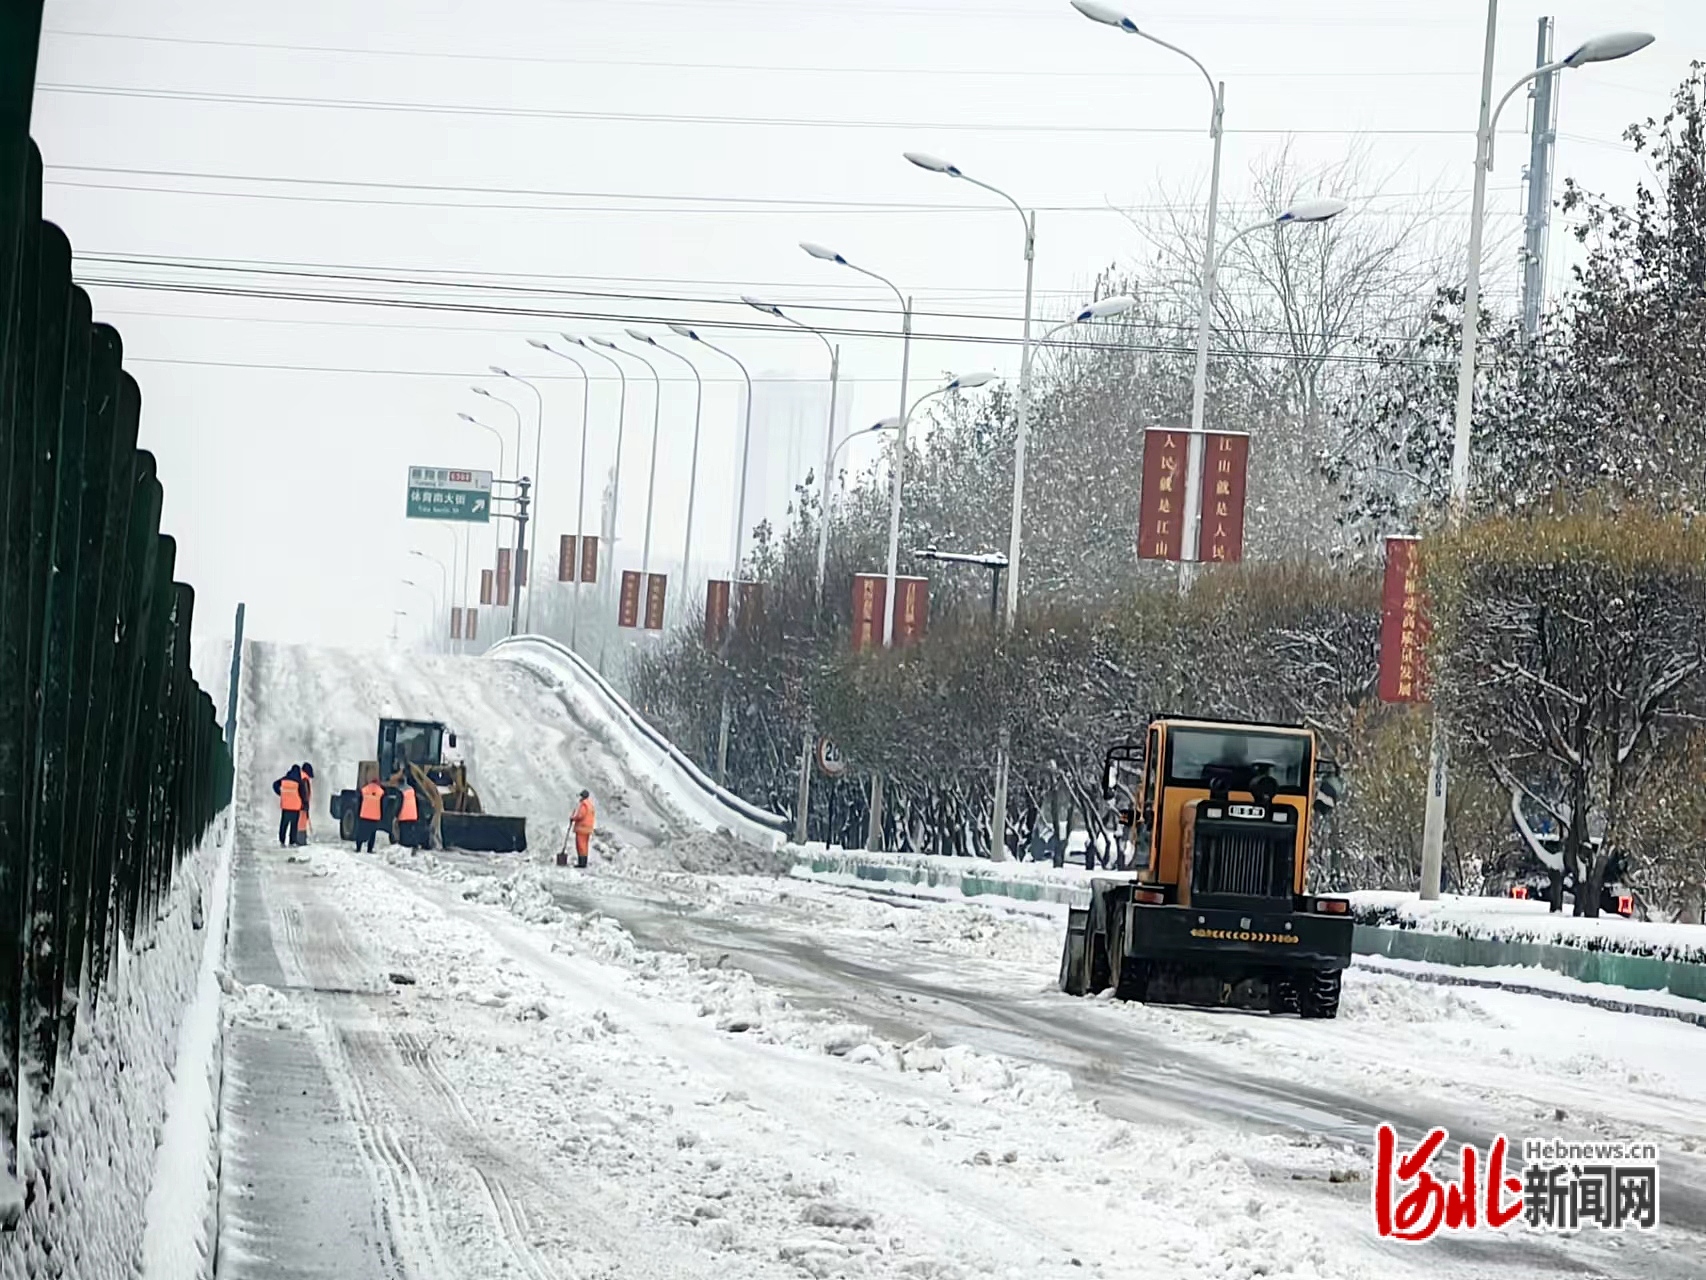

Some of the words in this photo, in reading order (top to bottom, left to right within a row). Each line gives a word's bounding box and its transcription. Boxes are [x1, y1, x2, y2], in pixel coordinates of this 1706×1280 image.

[1155, 433, 1177, 556] 人民就是江山
[1212, 436, 1233, 560] 江山就是人民
